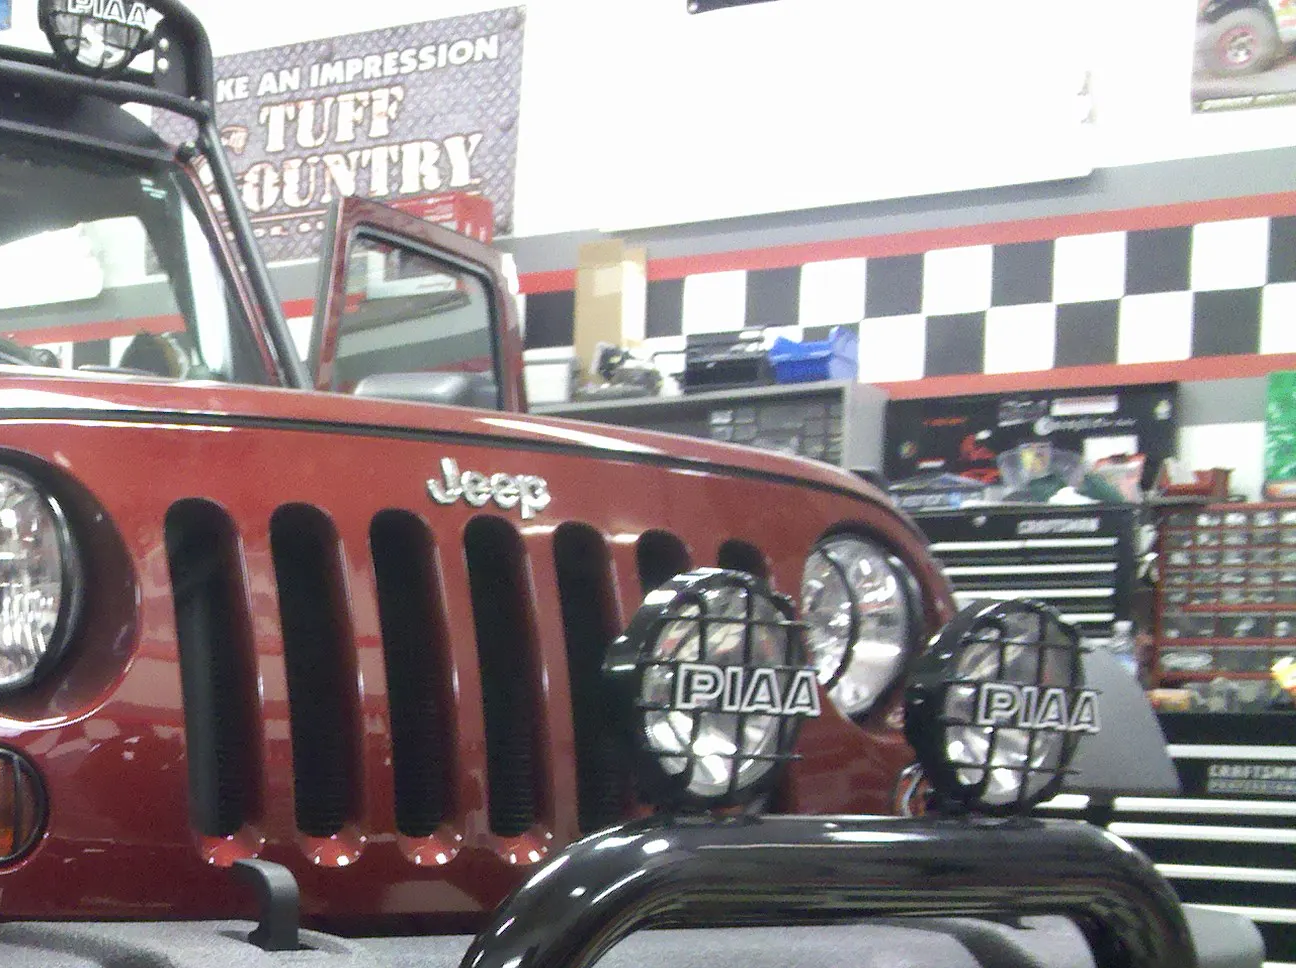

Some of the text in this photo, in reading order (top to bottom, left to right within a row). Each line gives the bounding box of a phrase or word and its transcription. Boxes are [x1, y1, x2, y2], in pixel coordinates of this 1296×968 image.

[67, 0, 147, 29] PIAA
[216, 34, 501, 103] KE AN IMPRESSION
[258, 85, 405, 153] TUFF
[426, 456, 552, 520] Jeep
[675, 664, 821, 716] PIAA
[977, 683, 1101, 733] PIAA
